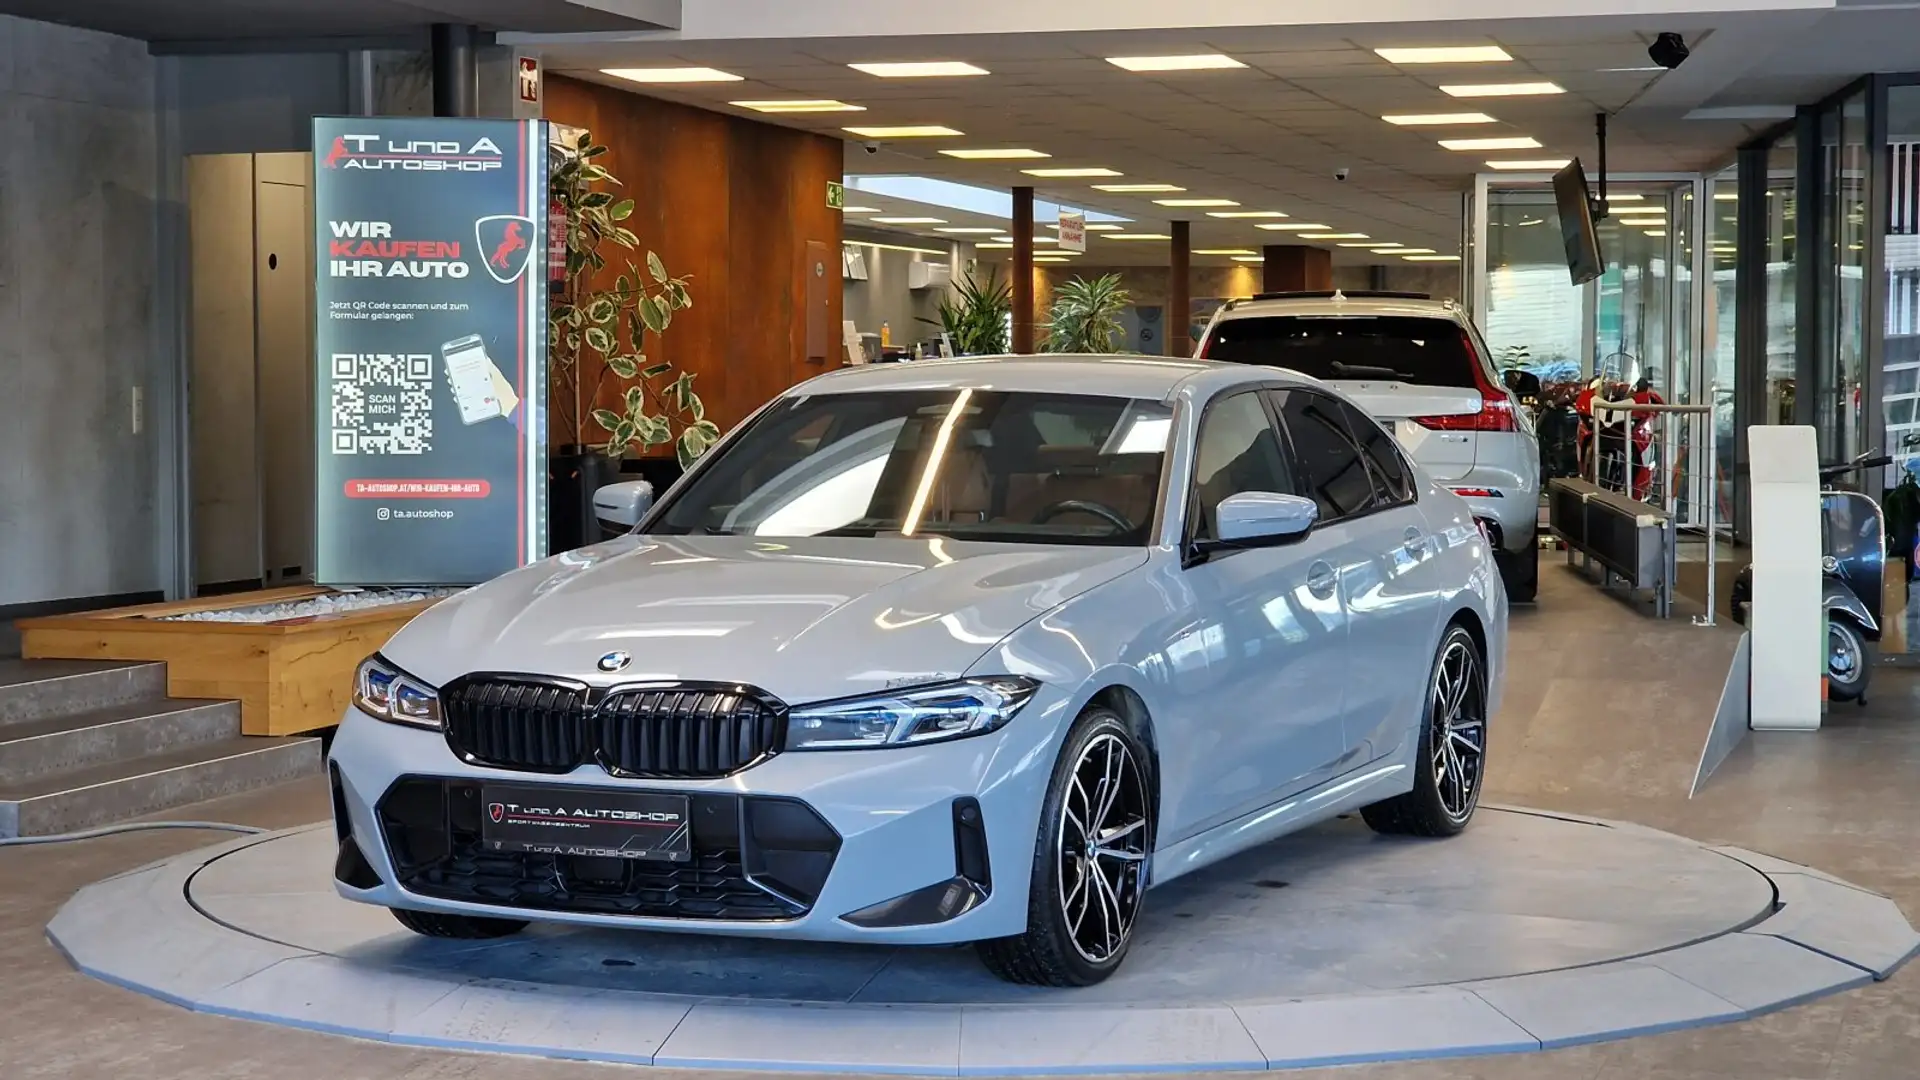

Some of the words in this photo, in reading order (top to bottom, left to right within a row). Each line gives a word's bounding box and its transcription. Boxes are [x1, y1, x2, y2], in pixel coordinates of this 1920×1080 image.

[343, 134, 380, 152] T
[467, 137, 503, 155] A
[343, 159, 502, 172] AUTOSHOP
[329, 221, 392, 238] WIR
[330, 241, 460, 258] KAUFEN
[330, 260, 384, 278] IHR
[386, 260, 470, 279] AUTO
[329, 301, 351, 310] Jetzt
[352, 301, 367, 311] QR
[368, 301, 391, 310] Code
[430, 301, 448, 310] und
[449, 303, 469, 311] zum
[329, 311, 370, 320] Formular
[371, 312, 414, 321] gelangen:
[368, 394, 396, 404] SCAN
[368, 404, 396, 415] MICH
[393, 508, 454, 519] ta.autoshop
[506, 803, 520, 813] T
[555, 807, 568, 816] A
[572, 808, 680, 821] AUTOSHOP
[552, 845, 563, 854] A
[567, 846, 647, 858] AUTOSHOP
